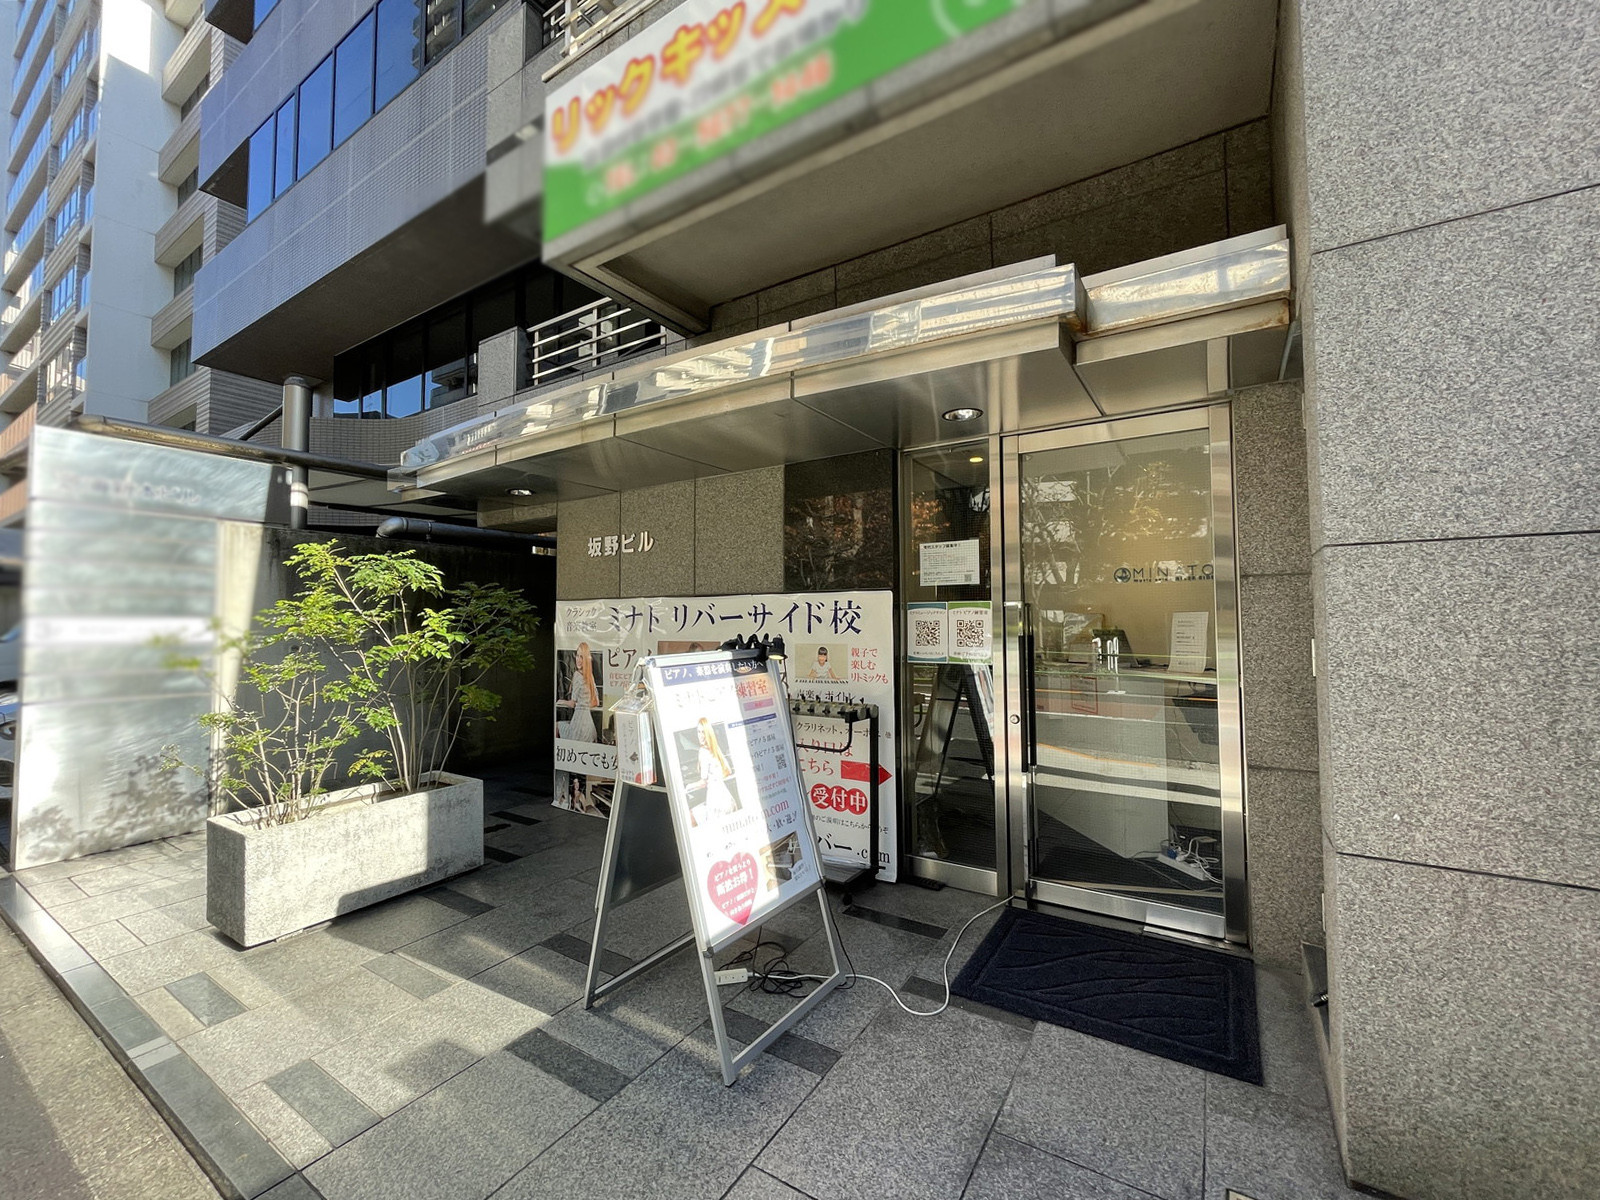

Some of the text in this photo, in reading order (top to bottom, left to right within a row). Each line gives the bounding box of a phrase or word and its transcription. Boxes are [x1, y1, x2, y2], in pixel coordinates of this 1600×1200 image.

[588, 531, 655, 558] 坂野ビル
[851, 647, 878, 658] 親子で
[851, 660, 877, 671] 楽しむ
[850, 672, 889, 685] リトミックも
[813, 787, 866, 812] 受付中
